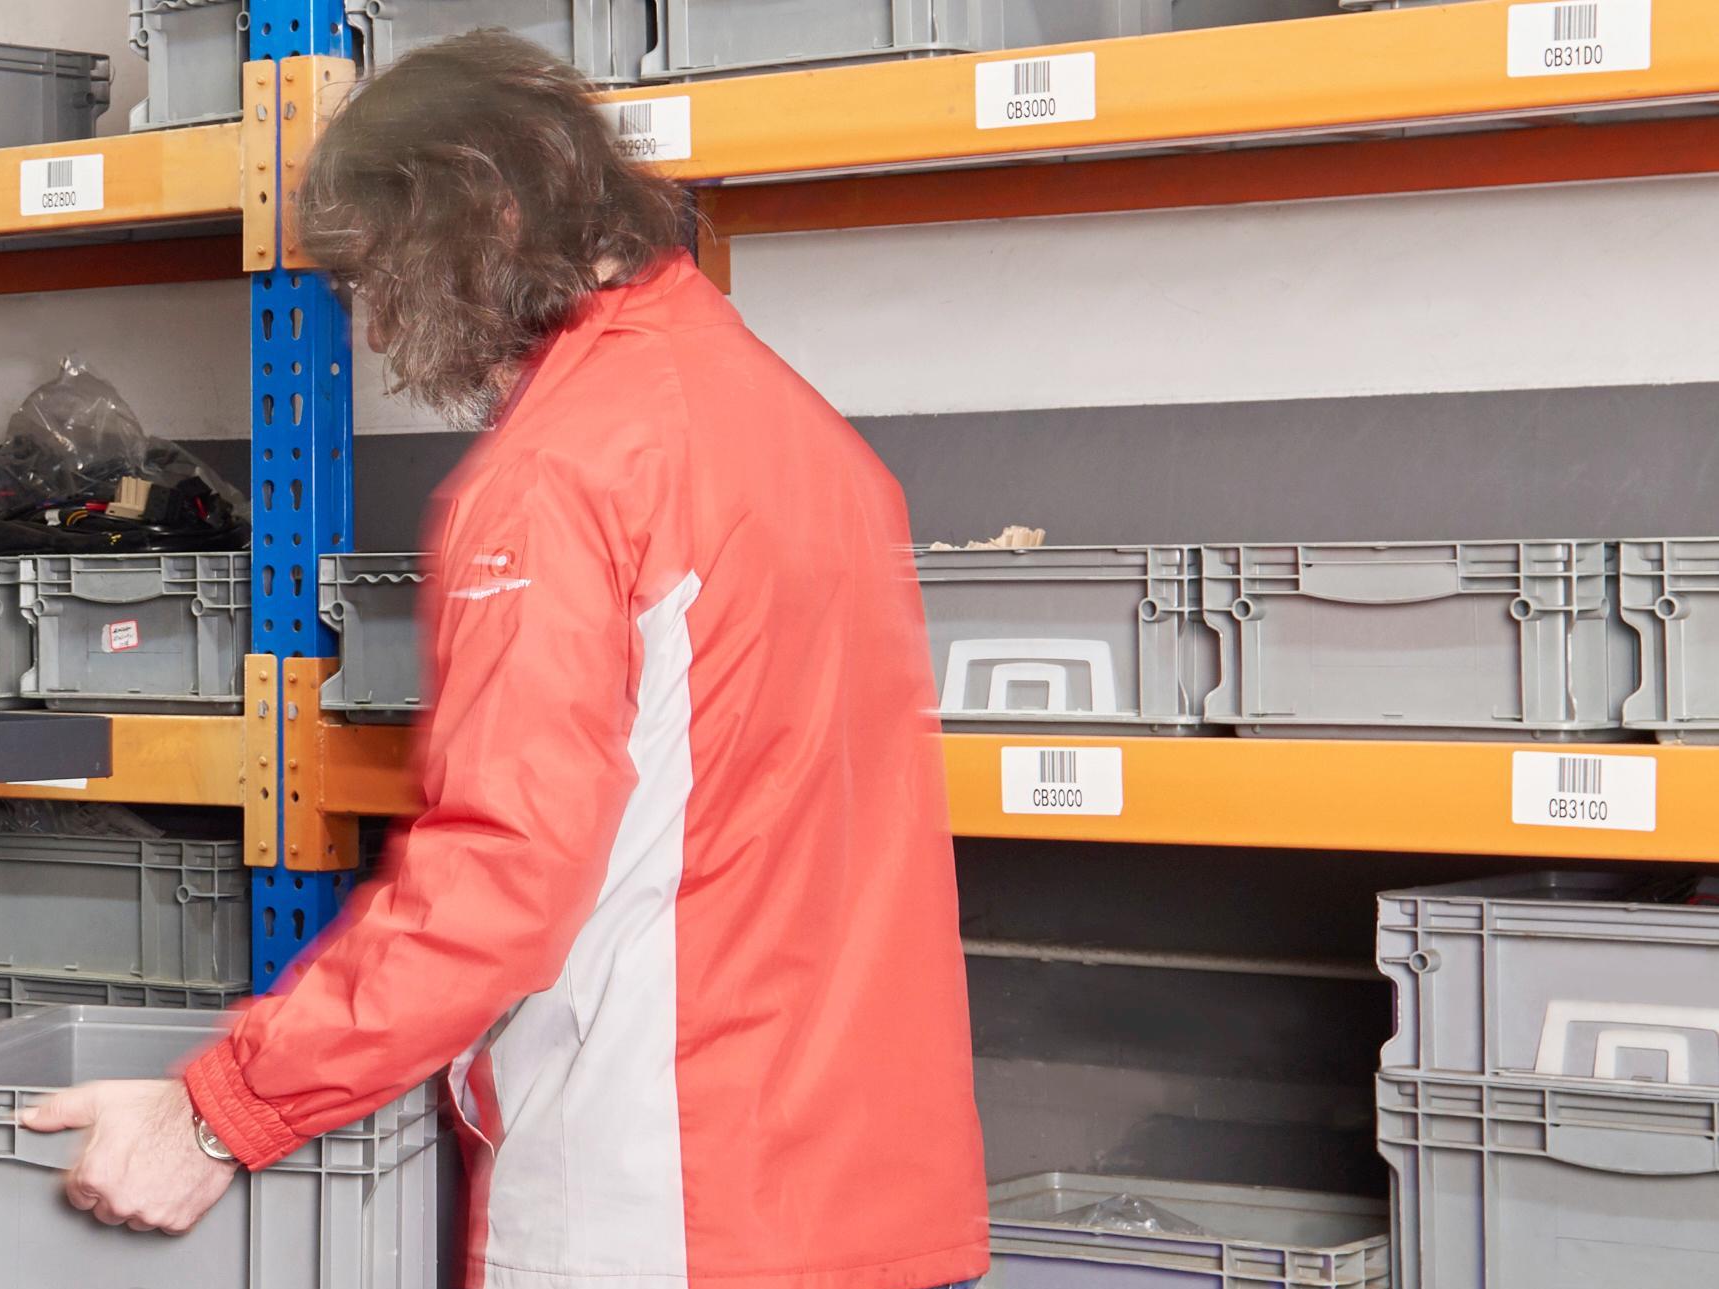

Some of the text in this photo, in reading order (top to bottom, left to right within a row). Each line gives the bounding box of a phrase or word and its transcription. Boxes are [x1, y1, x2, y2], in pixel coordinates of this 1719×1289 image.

[1545, 45, 1602, 67] CB31D0
[1007, 98, 1056, 119] CB30D0
[42, 191, 76, 208] CB28D0
[1033, 789, 1082, 807] CB30C0
[1549, 798, 1607, 820] CB31C0
